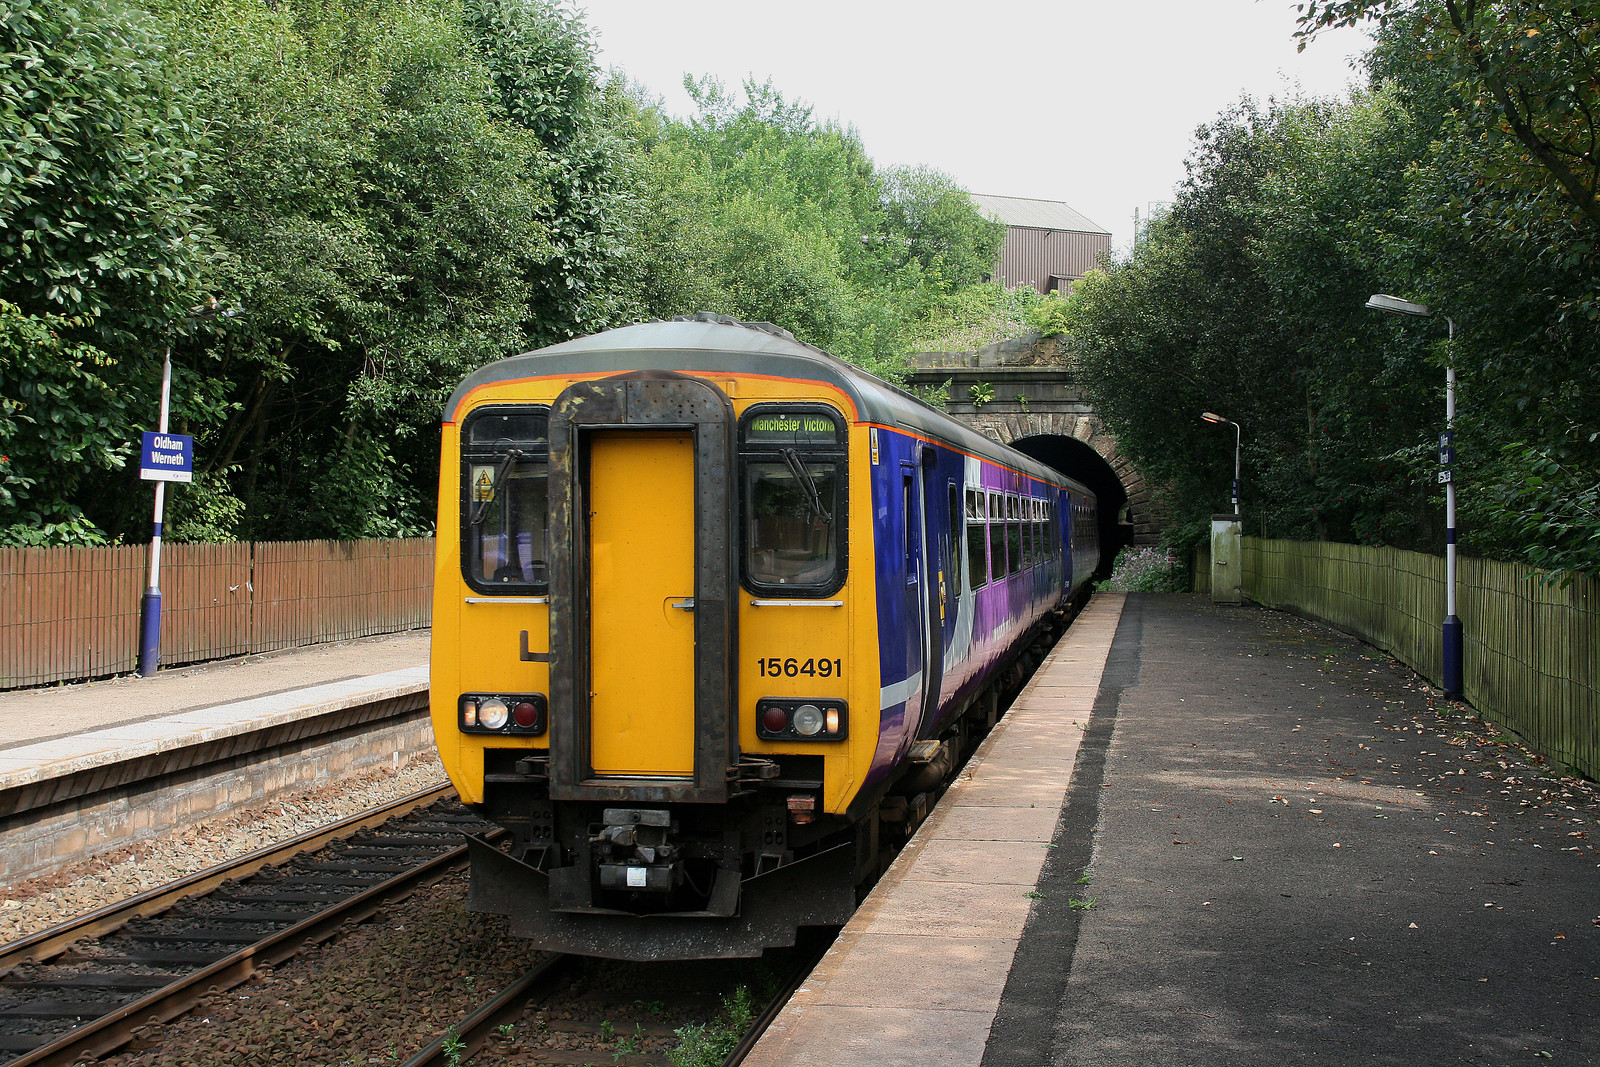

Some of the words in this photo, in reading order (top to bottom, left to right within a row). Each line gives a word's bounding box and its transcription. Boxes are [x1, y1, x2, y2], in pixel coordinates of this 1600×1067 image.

[752, 417, 800, 431] Manchester
[803, 417, 835, 432] Victoria
[154, 436, 183, 450] Oldham
[151, 451, 184, 465] Werneth
[757, 657, 842, 677] 156491
